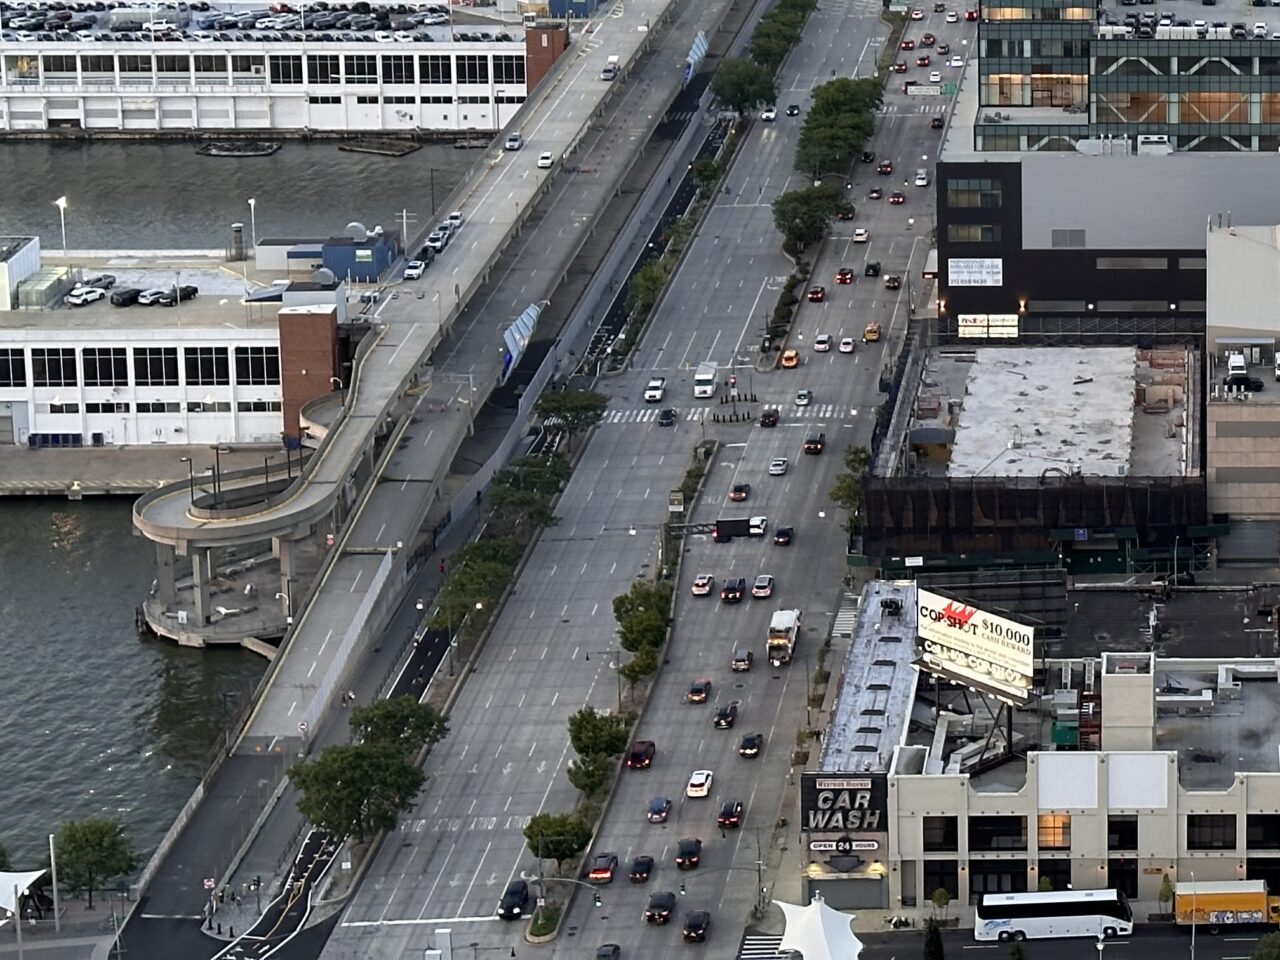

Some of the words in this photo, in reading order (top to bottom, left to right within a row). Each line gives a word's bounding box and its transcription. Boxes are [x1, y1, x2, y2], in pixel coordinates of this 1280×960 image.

[981, 618, 1030, 647] $10,000
[1001, 638, 1031, 656] REWARD
[817, 790, 871, 809] CAR
[808, 810, 880, 829] WASH
[838, 842, 850, 850] 24
